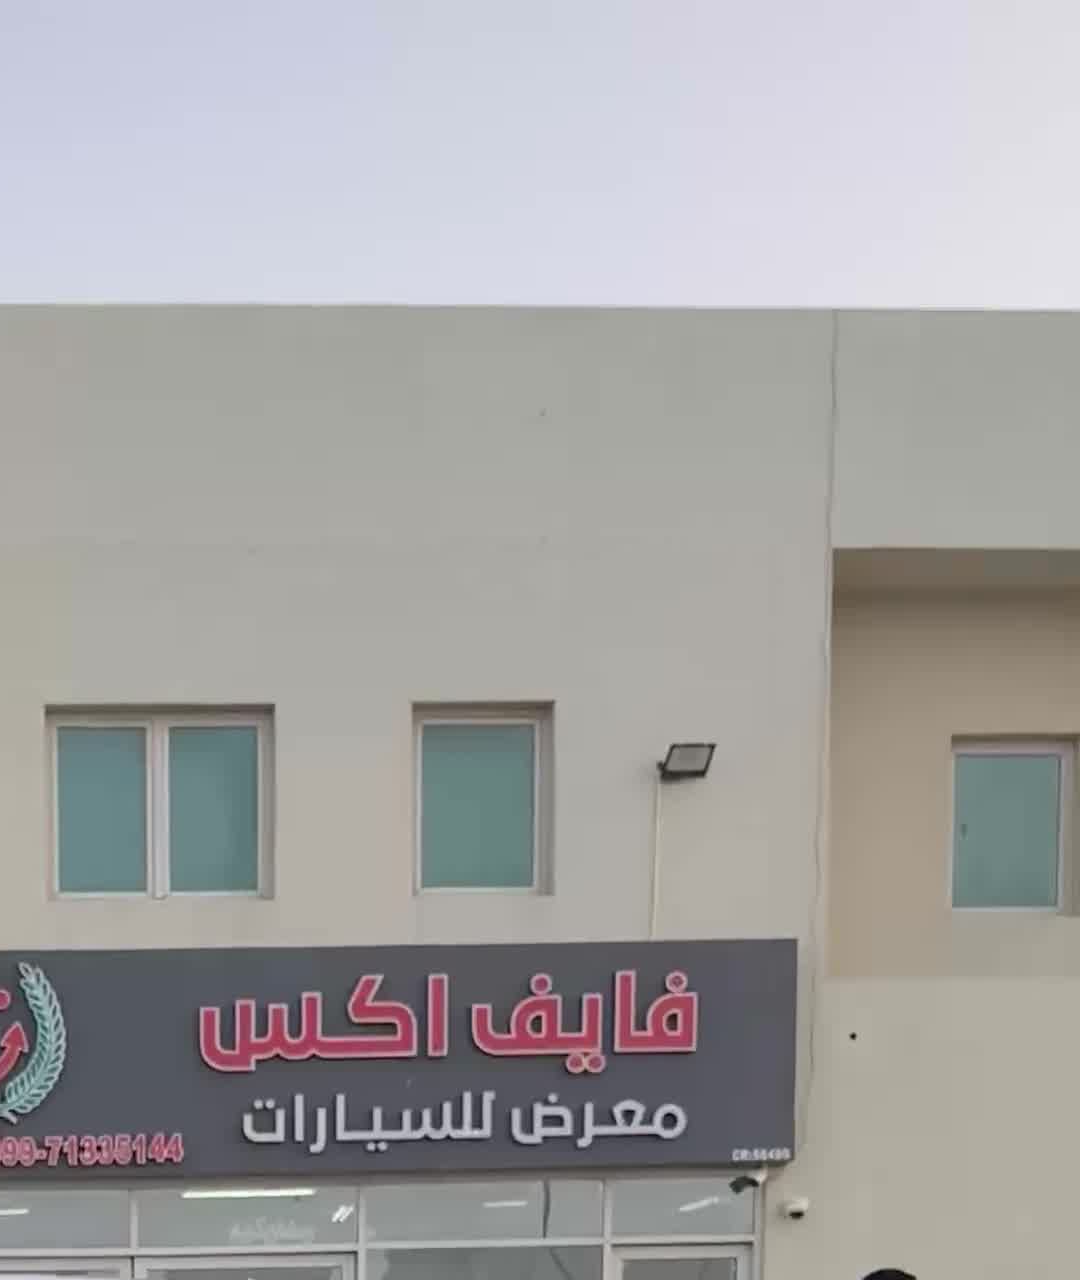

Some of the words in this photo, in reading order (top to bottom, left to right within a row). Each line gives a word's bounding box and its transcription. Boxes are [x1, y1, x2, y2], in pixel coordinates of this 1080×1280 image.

[200, 973, 449, 1072] اكس
[471, 970, 699, 1074] فايف
[241, 1091, 497, 1153] للسيارات
[511, 1093, 687, 1148] معرض
